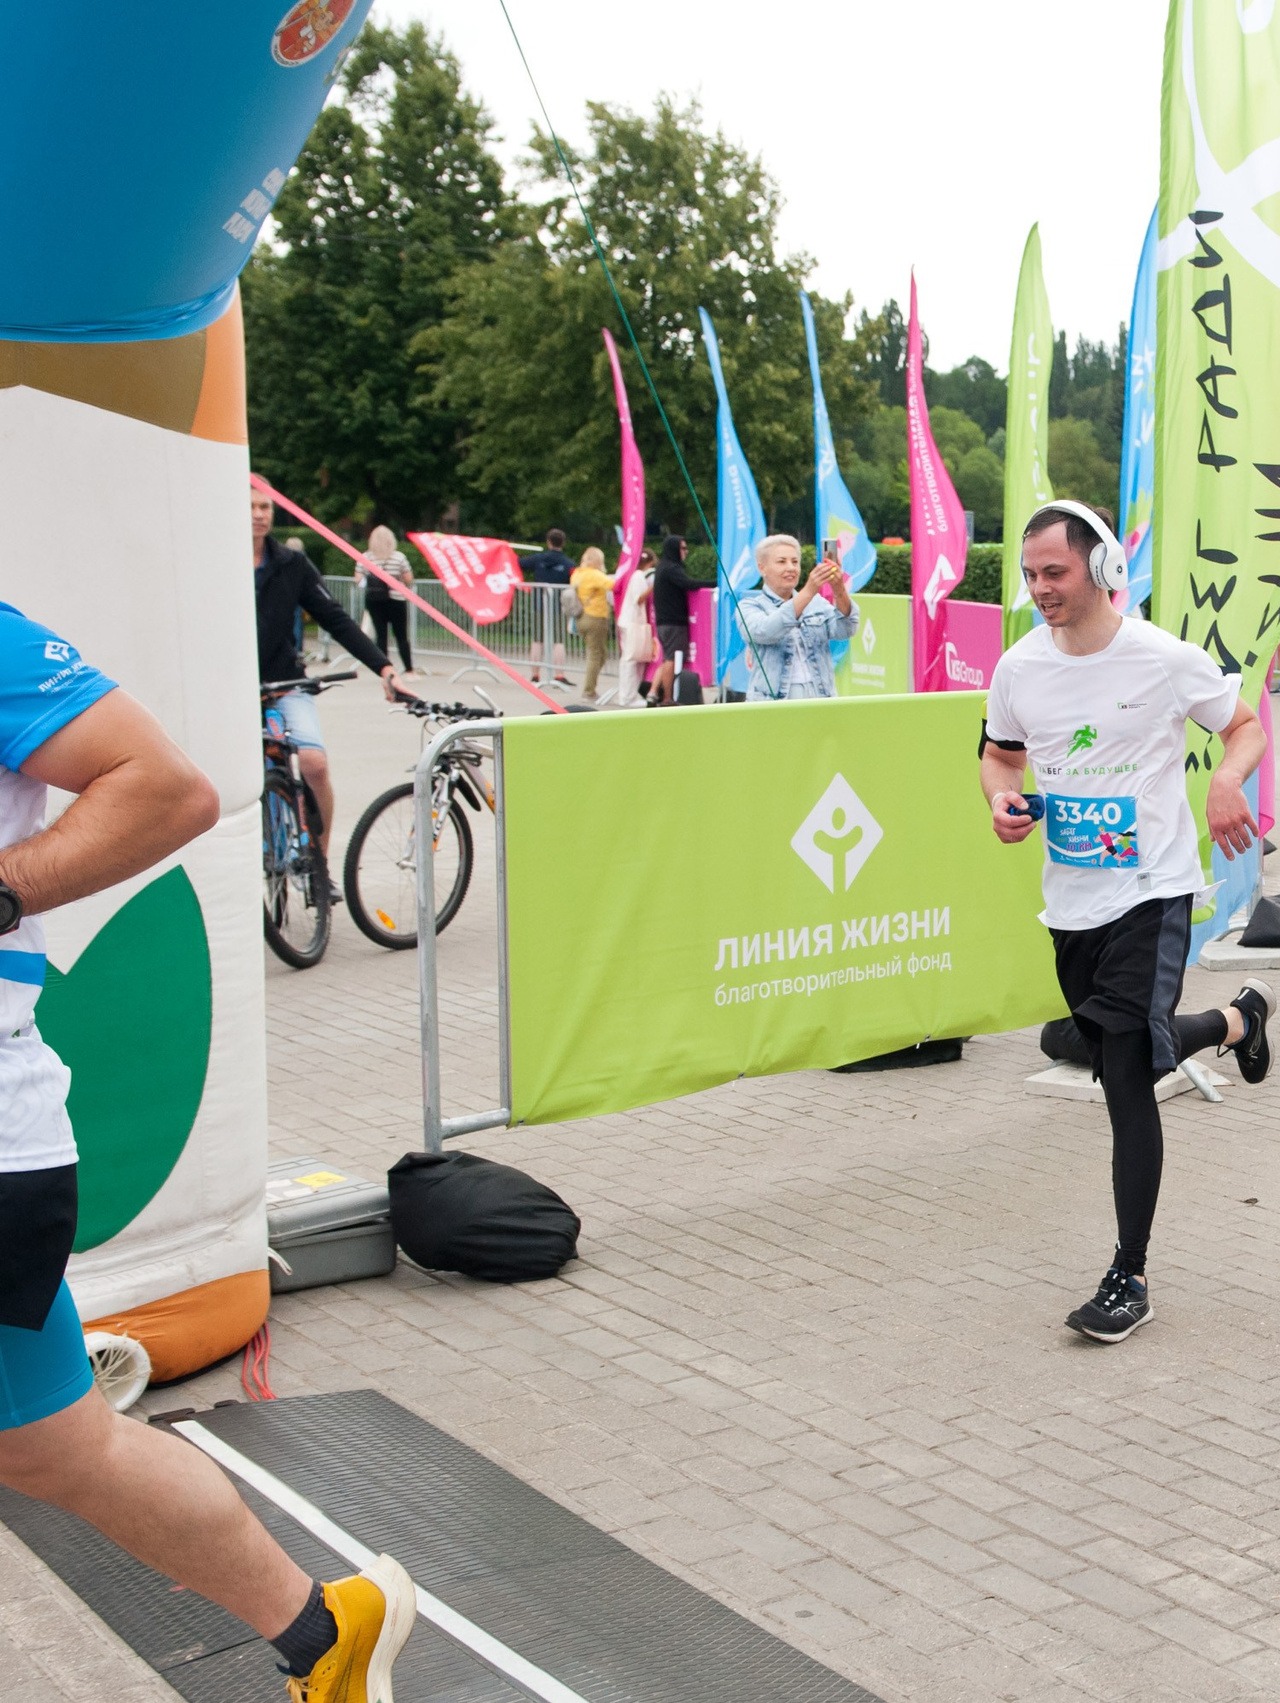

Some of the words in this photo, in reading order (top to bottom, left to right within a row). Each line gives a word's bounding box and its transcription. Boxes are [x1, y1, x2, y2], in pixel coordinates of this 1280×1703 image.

[1188, 209, 1238, 473] РАДИ
[1066, 767, 1079, 776] ЗА
[1054, 799, 1122, 825] 3340
[714, 924, 833, 972] ЛИНИЯ
[841, 905, 950, 951] ЖИЗНИ
[714, 955, 902, 1007] благотворительный
[907, 952, 952, 978] фонд
